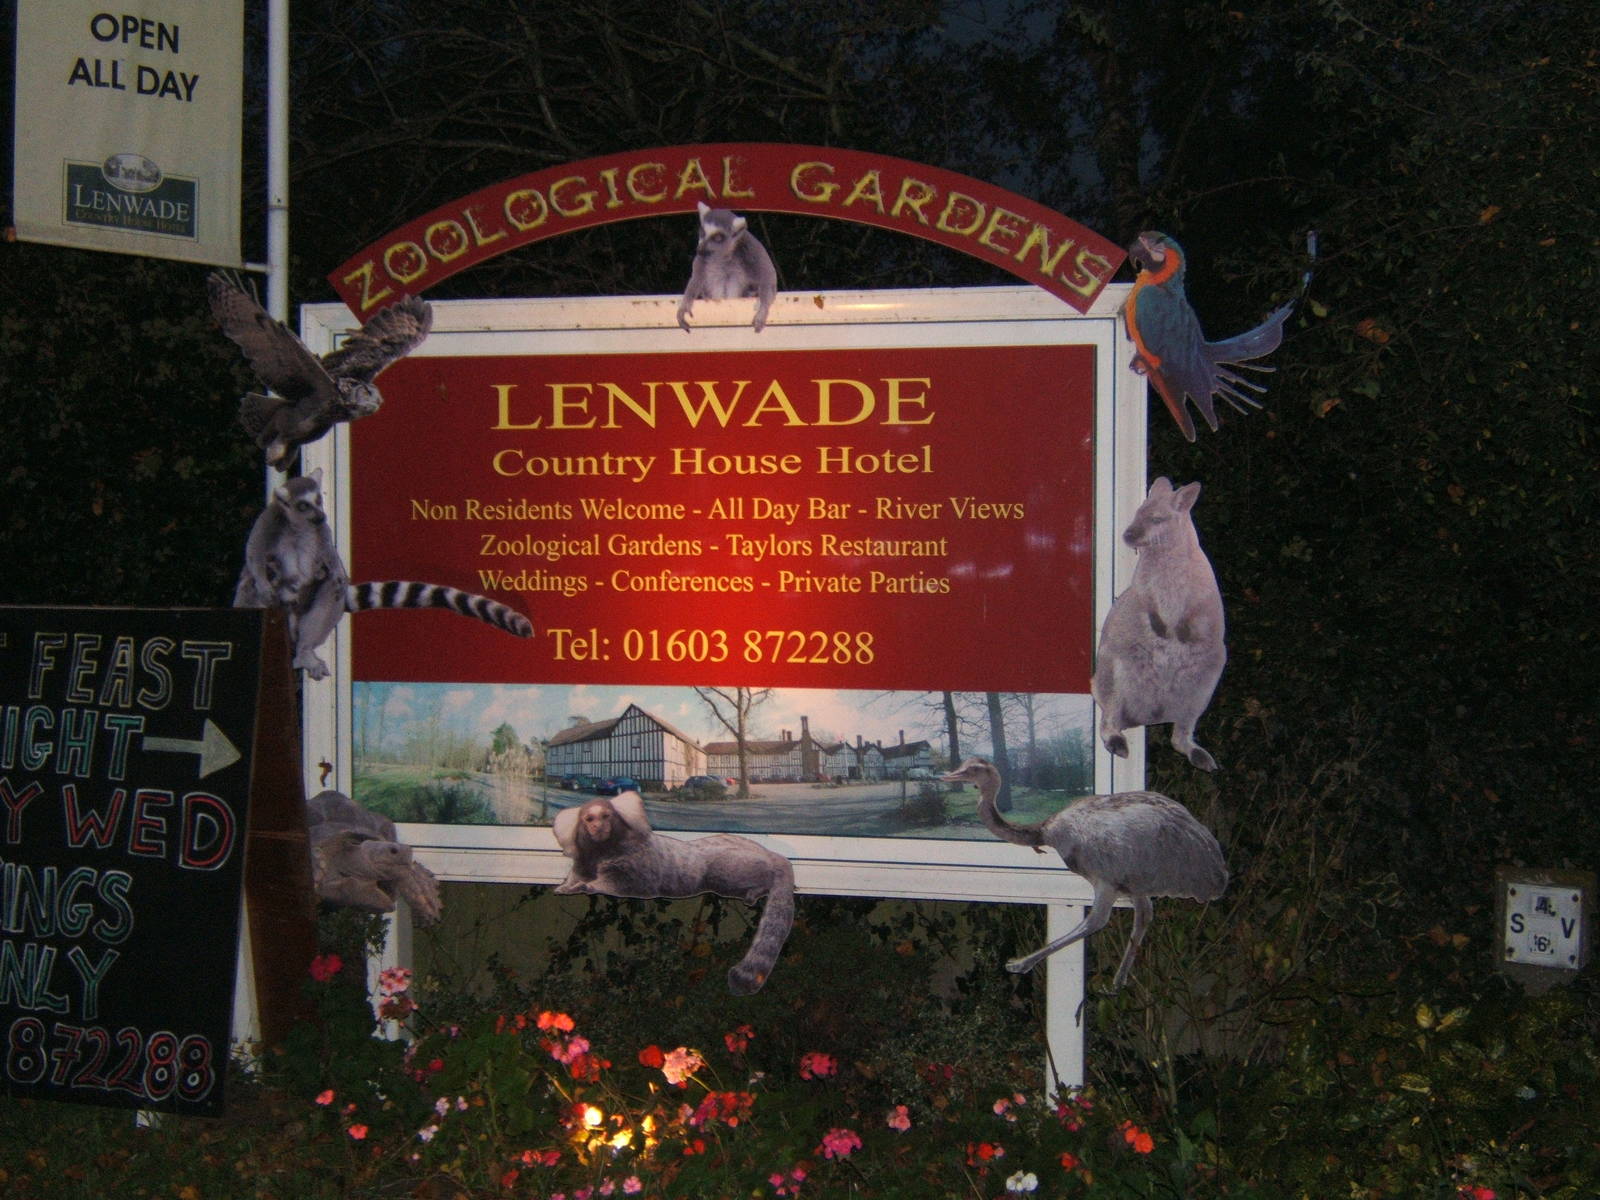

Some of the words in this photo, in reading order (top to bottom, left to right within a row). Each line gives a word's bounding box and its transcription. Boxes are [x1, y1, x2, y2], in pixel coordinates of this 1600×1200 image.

[90, 12, 180, 54] OPEN
[67, 57, 126, 91] ALL
[136, 64, 200, 103] DAY
[74, 183, 190, 223] LENWADE
[343, 156, 756, 312] ZOOLOGICAL
[789, 161, 1113, 298] GARDENS
[490, 376, 936, 430] LENWADE
[492, 449, 657, 483] Country
[670, 447, 802, 475] House
[815, 444, 935, 474] Hotel
[411, 499, 458, 521] Non
[465, 498, 573, 521] Residents
[580, 497, 686, 521] Welcome
[707, 496, 745, 520] All
[751, 497, 801, 526] Day
[807, 497, 852, 520] Bar
[875, 496, 943, 520] River
[949, 496, 1025, 520] Views
[479, 533, 601, 562] Zoological
[607, 533, 703, 557] Gardens
[725, 533, 813, 563] Taylors
[820, 533, 948, 557] Restaurant
[477, 569, 589, 598] Weddings
[611, 568, 755, 593] Conferences
[778, 569, 862, 593] Private
[869, 570, 951, 594] Parties
[546, 627, 611, 661] Tel:
[622, 628, 730, 663] 01603
[743, 629, 875, 665] 872288
[27, 631, 233, 711] FEAST
[0, 704, 146, 781] IGHT
[62, 783, 237, 871] WED
[0, 857, 135, 944] INGS
[1510, 913, 1524, 933] S
[1561, 917, 1575, 938] V
[7, 1016, 216, 1102] 872288
